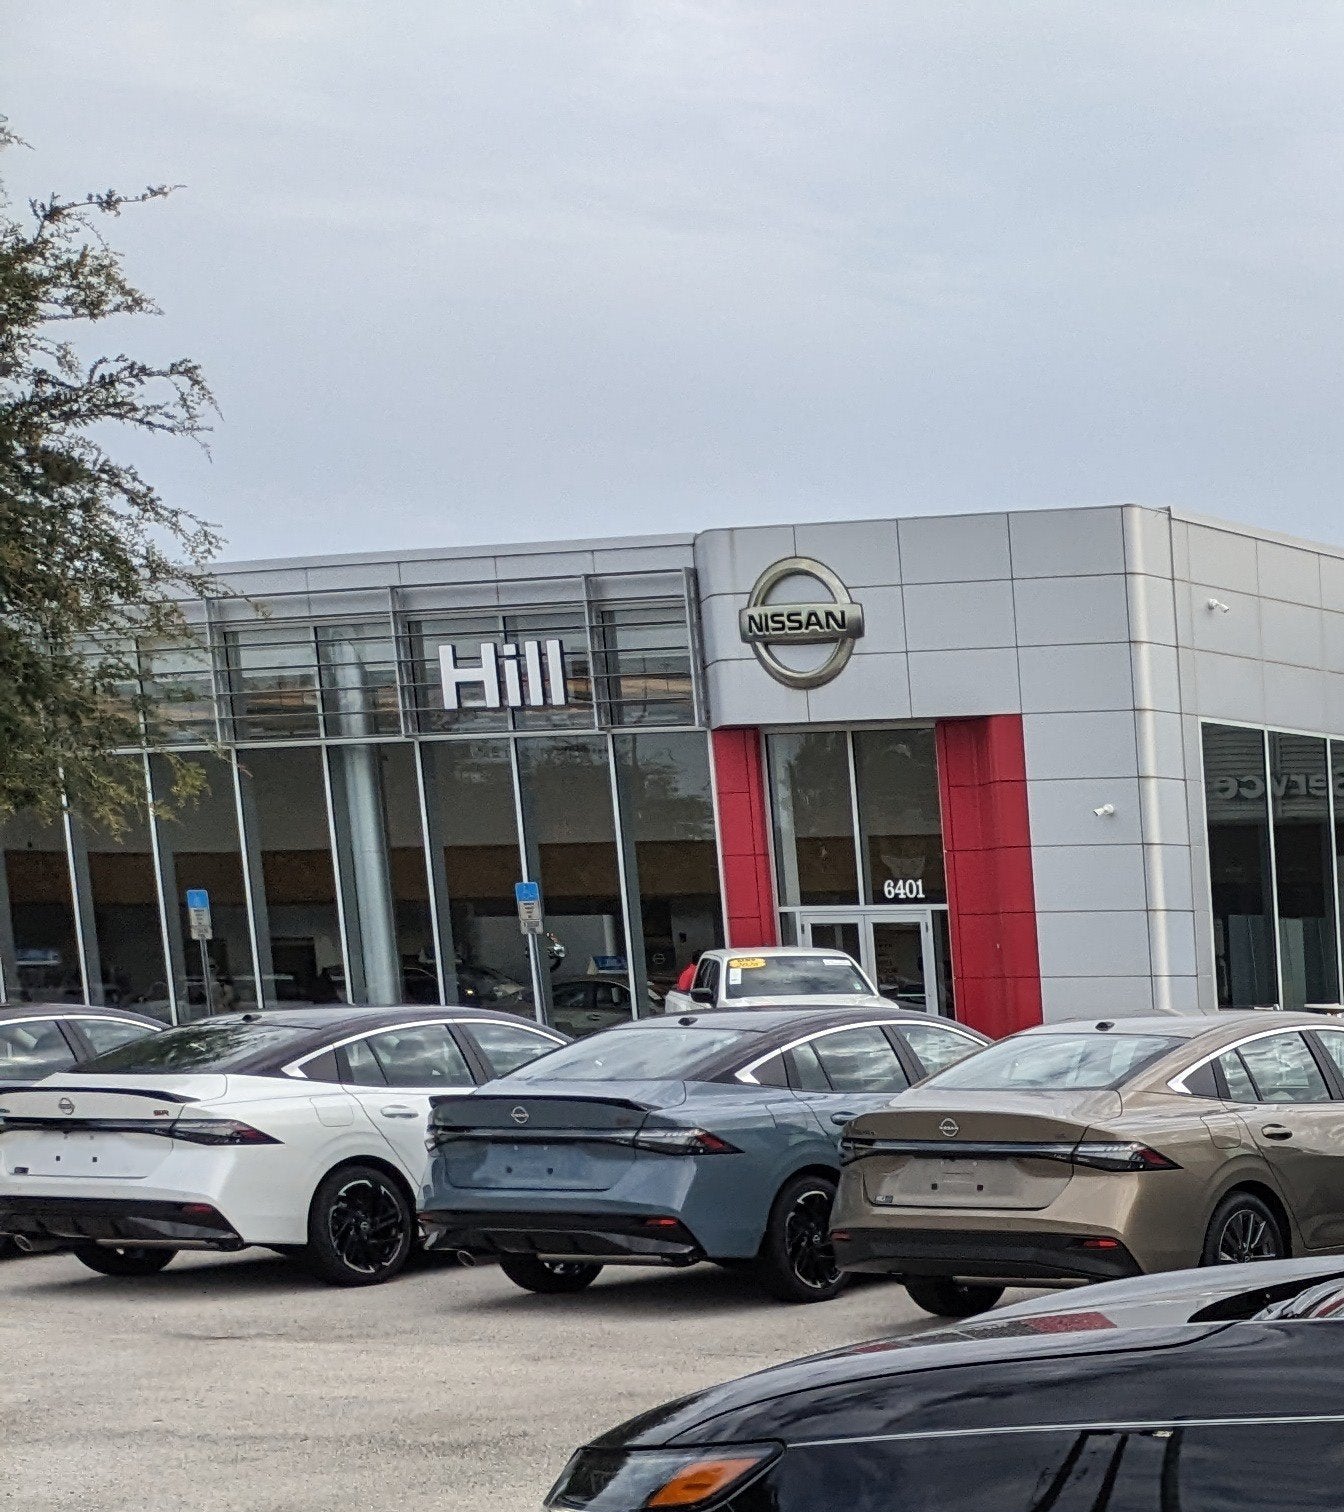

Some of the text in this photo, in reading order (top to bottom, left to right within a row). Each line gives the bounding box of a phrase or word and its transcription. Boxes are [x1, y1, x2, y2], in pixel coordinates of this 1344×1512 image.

[747, 609, 847, 634] NISSAN
[438, 639, 566, 710] Hill
[883, 878, 926, 899] 6401
